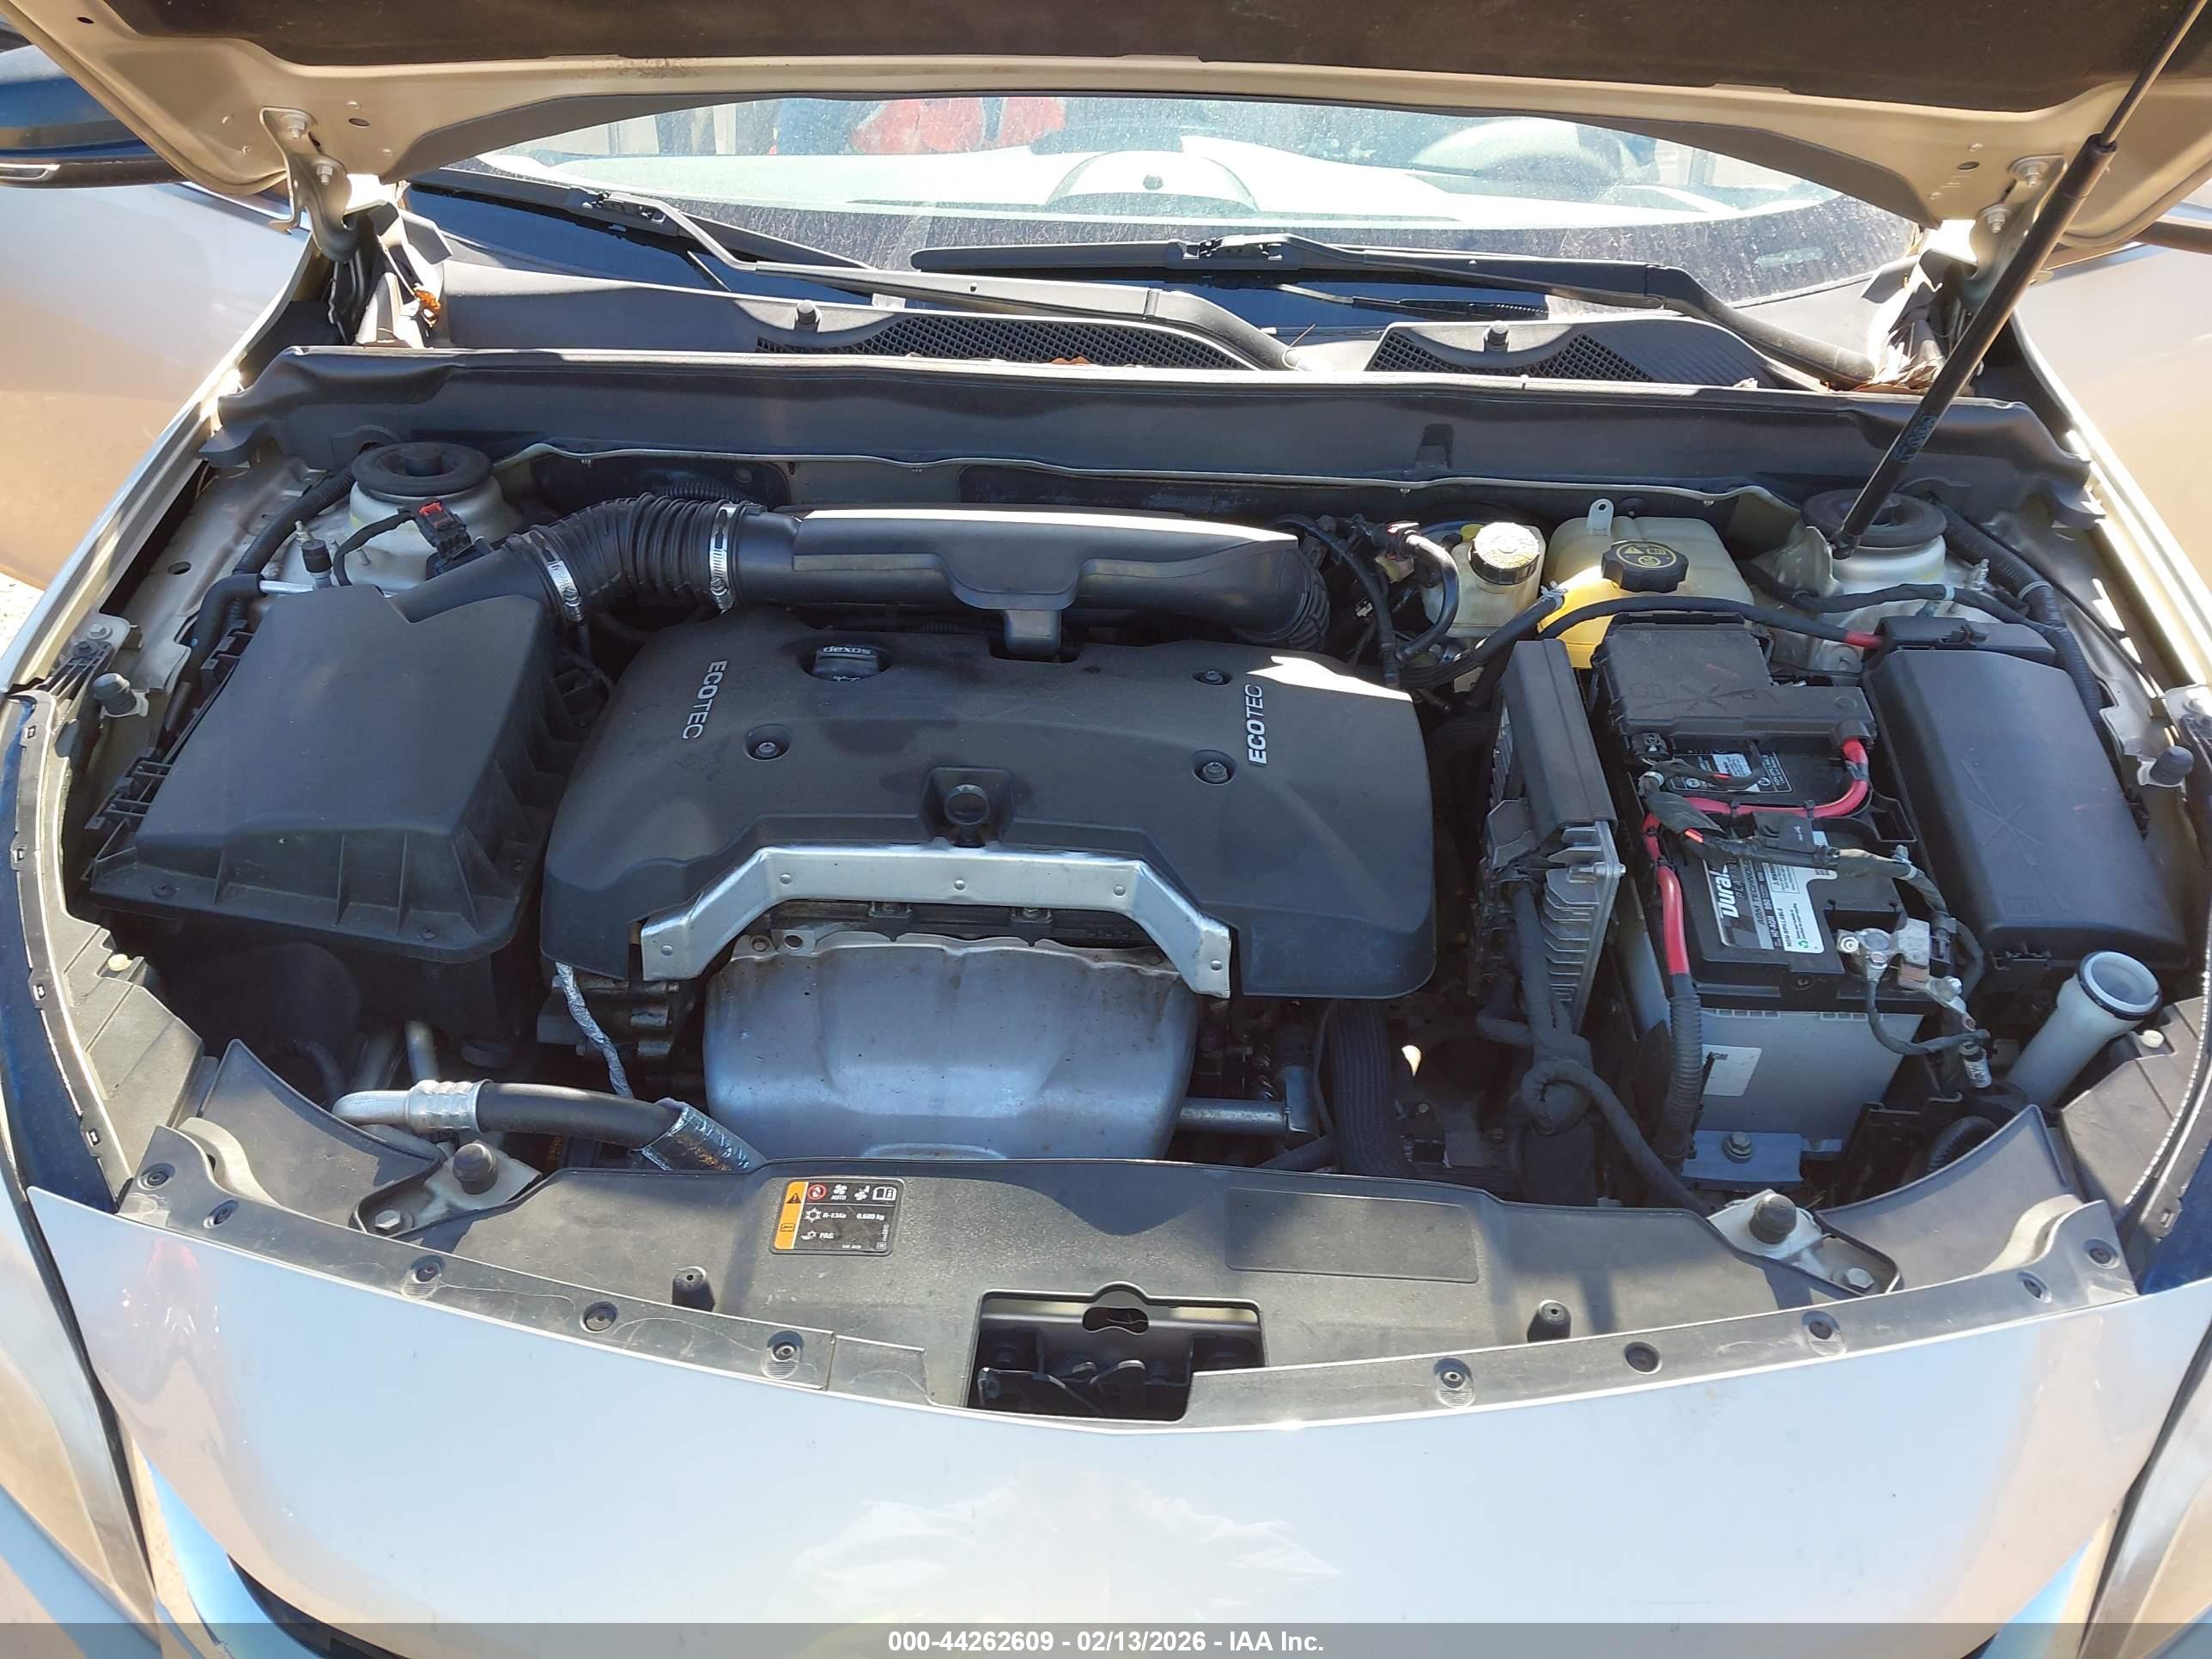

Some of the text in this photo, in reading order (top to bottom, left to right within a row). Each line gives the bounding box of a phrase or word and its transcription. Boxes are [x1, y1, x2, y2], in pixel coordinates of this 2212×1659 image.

[823, 646, 871, 654] dexos
[683, 660, 727, 738] ECOTEC
[1245, 684, 1267, 763] ECOTEC
[1709, 865, 1740, 919] Dural
[1753, 906, 1765, 926] AGM
